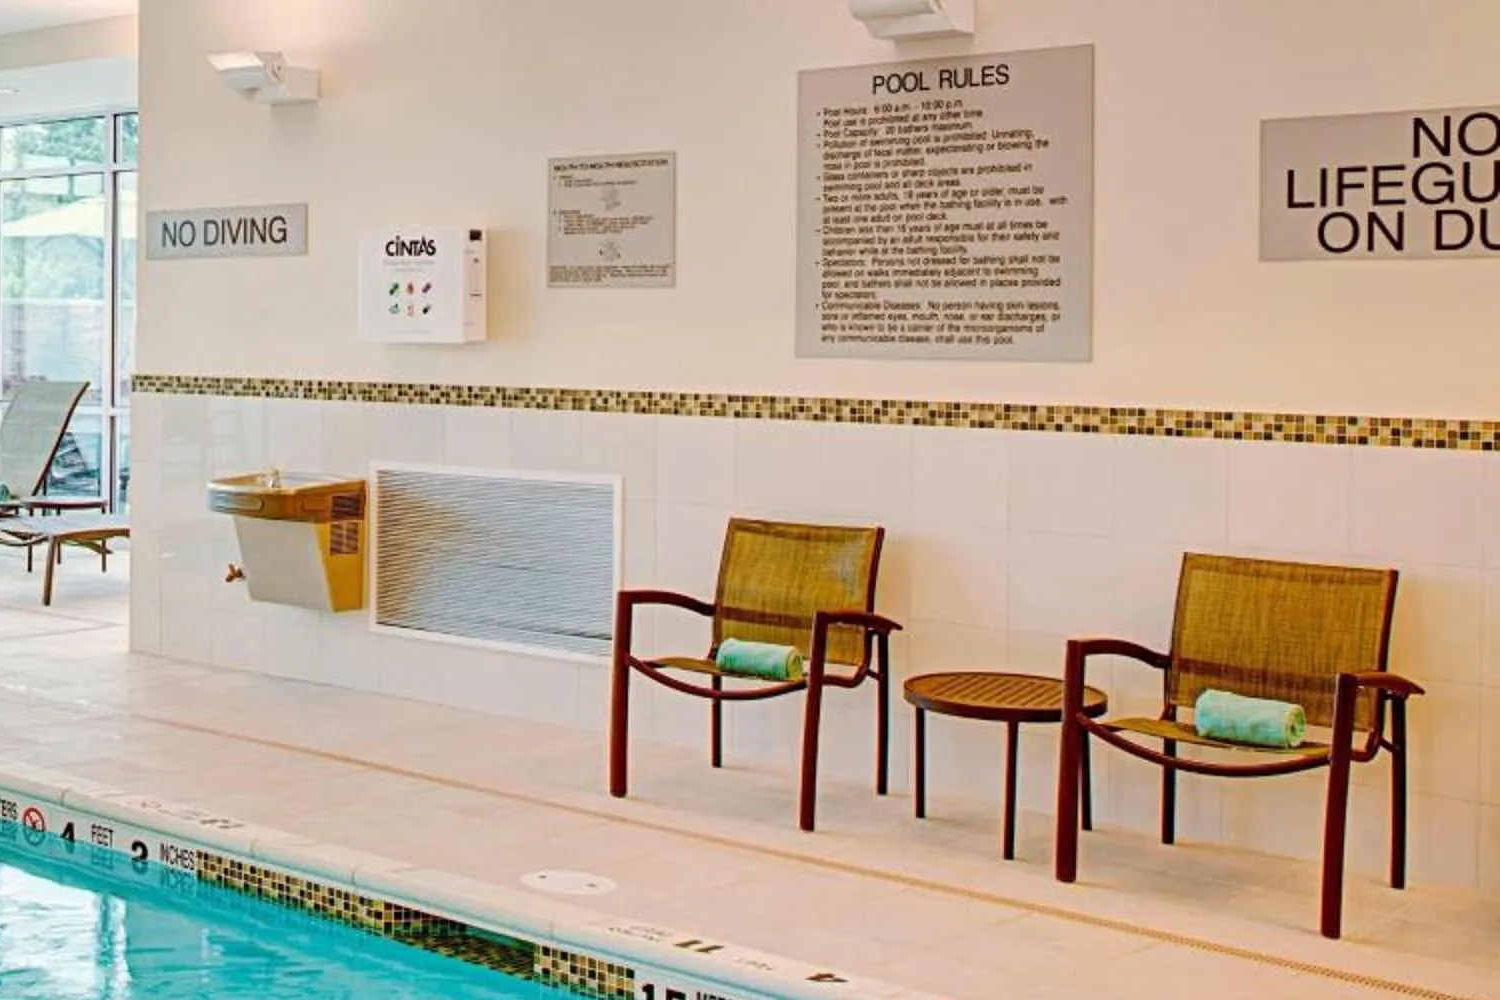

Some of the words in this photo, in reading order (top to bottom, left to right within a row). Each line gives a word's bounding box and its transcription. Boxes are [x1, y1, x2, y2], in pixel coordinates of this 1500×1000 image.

[872, 70, 930, 95] POOL
[939, 63, 1010, 90] RULES
[1412, 112, 1500, 158] NO
[162, 220, 196, 248] NO
[203, 206, 288, 247] DIVING
[1318, 210, 1404, 254] ON
[92, 824, 114, 848] FEET
[161, 843, 195, 872] INCHES
